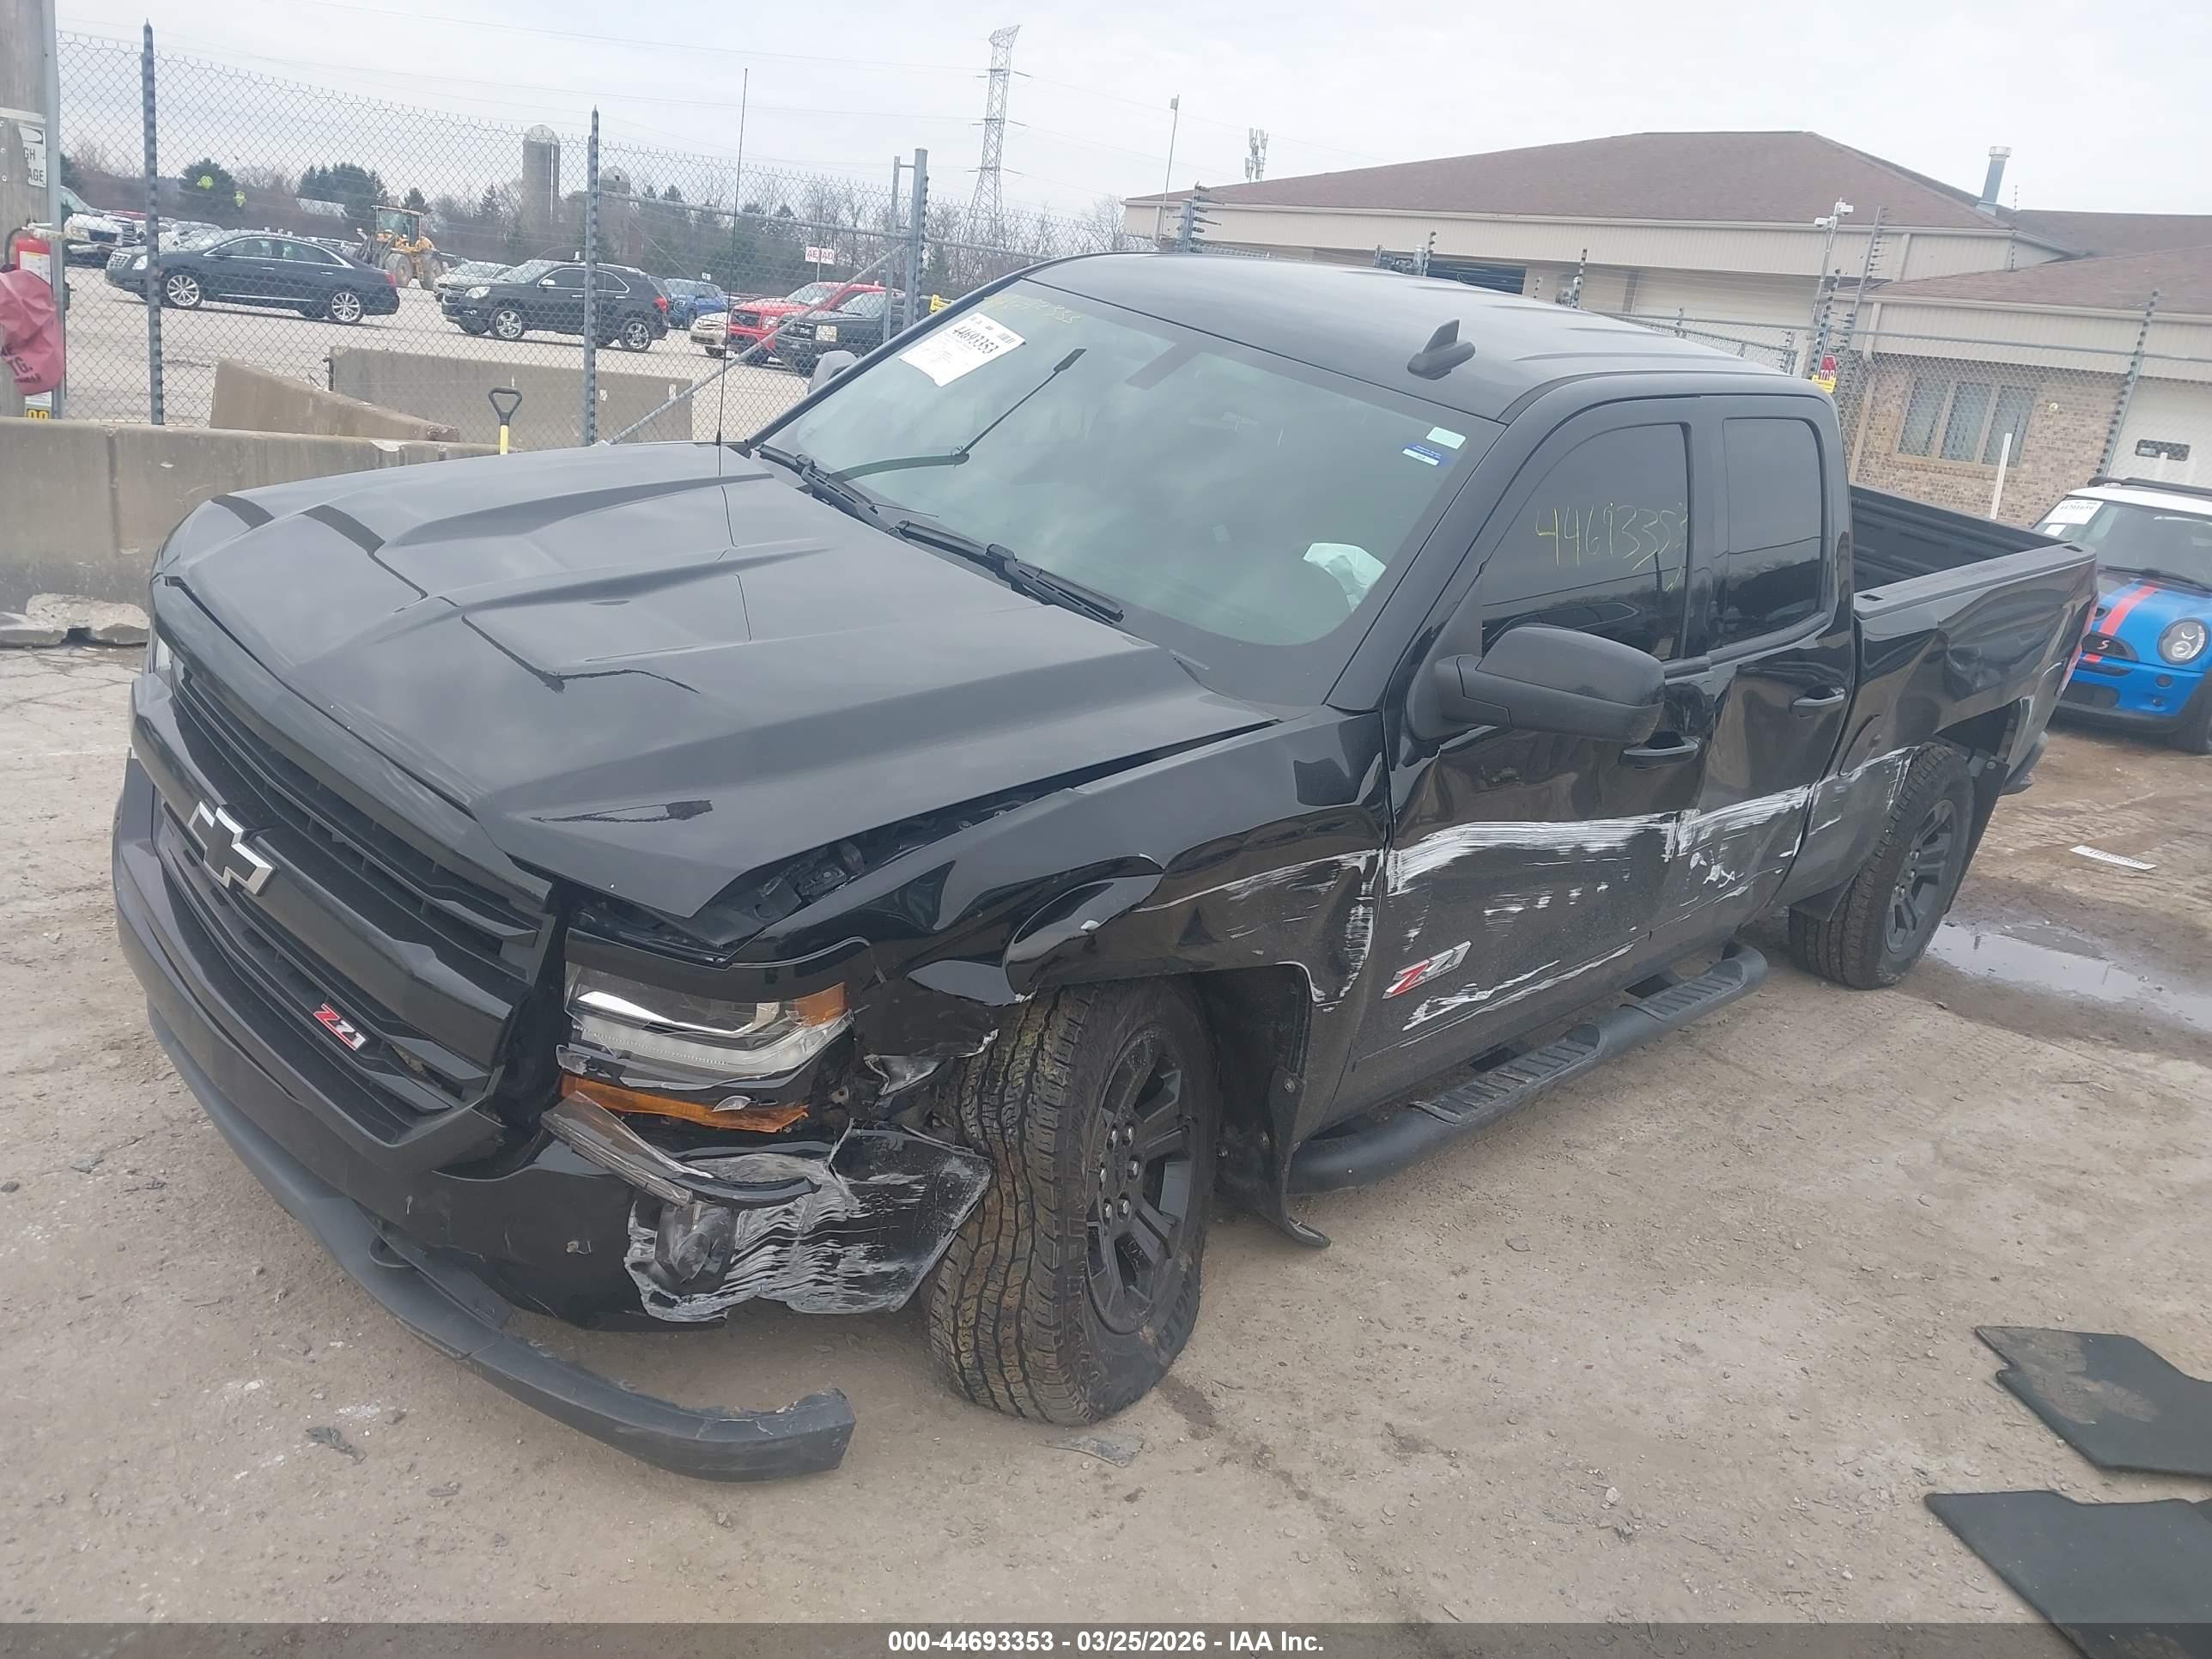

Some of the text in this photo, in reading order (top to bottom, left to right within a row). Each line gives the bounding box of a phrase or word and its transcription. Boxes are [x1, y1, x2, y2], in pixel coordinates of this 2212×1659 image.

[952, 325, 1000, 355] 44693353
[1381, 940, 1472, 1000] Z71
[313, 1002, 367, 1051] Z71
